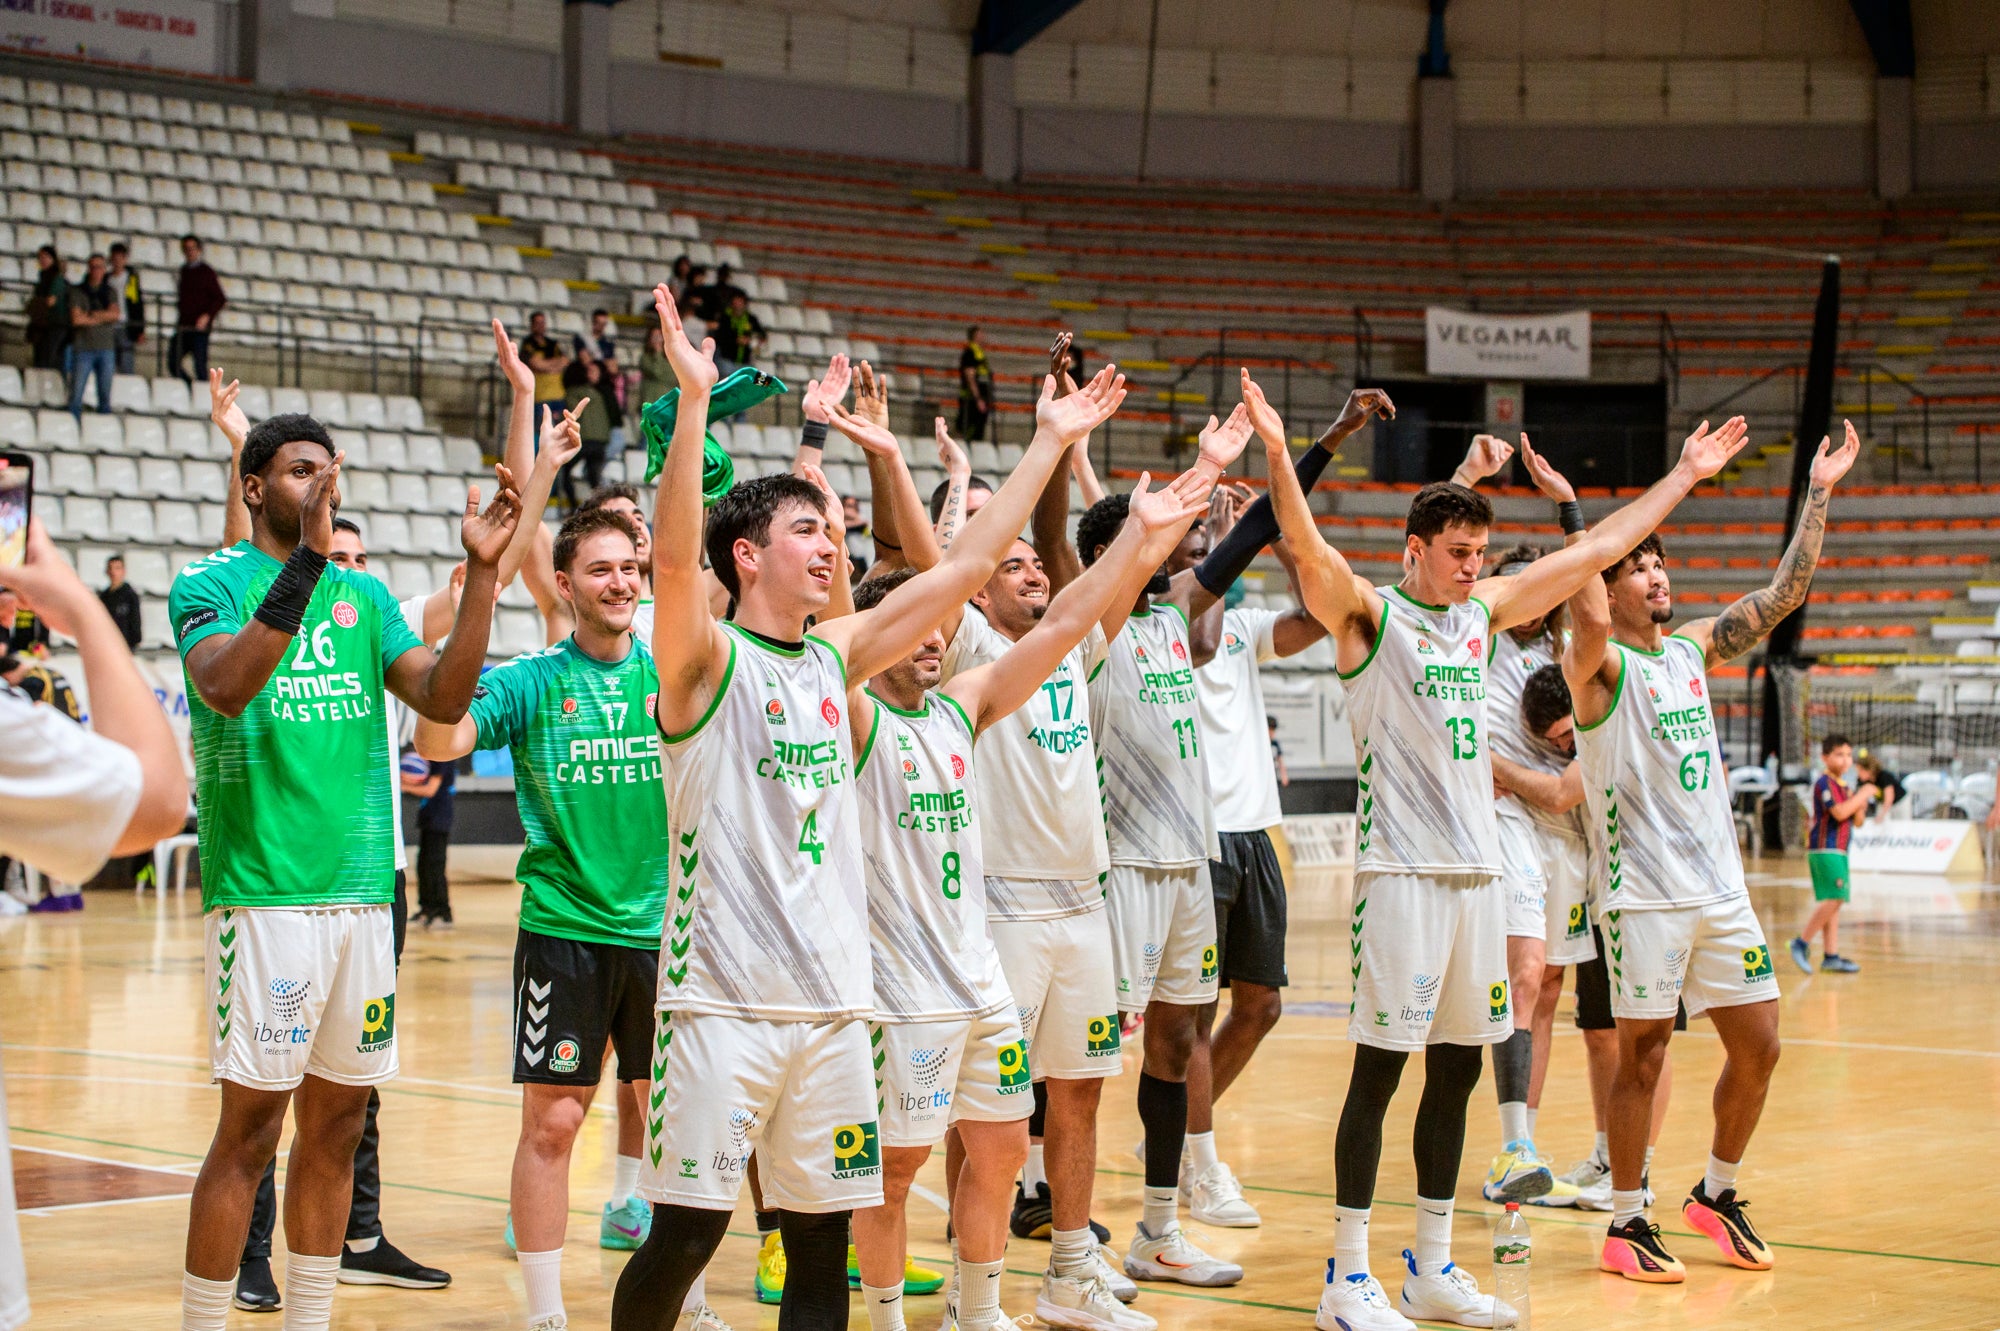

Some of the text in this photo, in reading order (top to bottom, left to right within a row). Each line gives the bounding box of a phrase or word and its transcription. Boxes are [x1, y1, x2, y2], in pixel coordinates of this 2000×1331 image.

[1437, 323, 1580, 352] VEGAMAR
[291, 620, 336, 671] 26
[276, 672, 362, 699] AMICS
[1144, 668, 1193, 689] AMICS
[1425, 665, 1481, 683] AMICS
[271, 692, 371, 722] CASTELLÓ
[1041, 680, 1073, 722] 17
[602, 702, 628, 731] 17
[1658, 705, 1706, 727] AMICS
[570, 735, 661, 762] AMICS
[1172, 717, 1198, 760] 11
[1445, 716, 1479, 760] 13
[1679, 750, 1711, 792] 67
[798, 808, 825, 865] 4
[941, 851, 961, 900] 8
[253, 1022, 311, 1044] ibertic
[264, 1048, 292, 1056] telecom
[900, 1088, 951, 1111] ibertic
[911, 1112, 936, 1122] telecom
